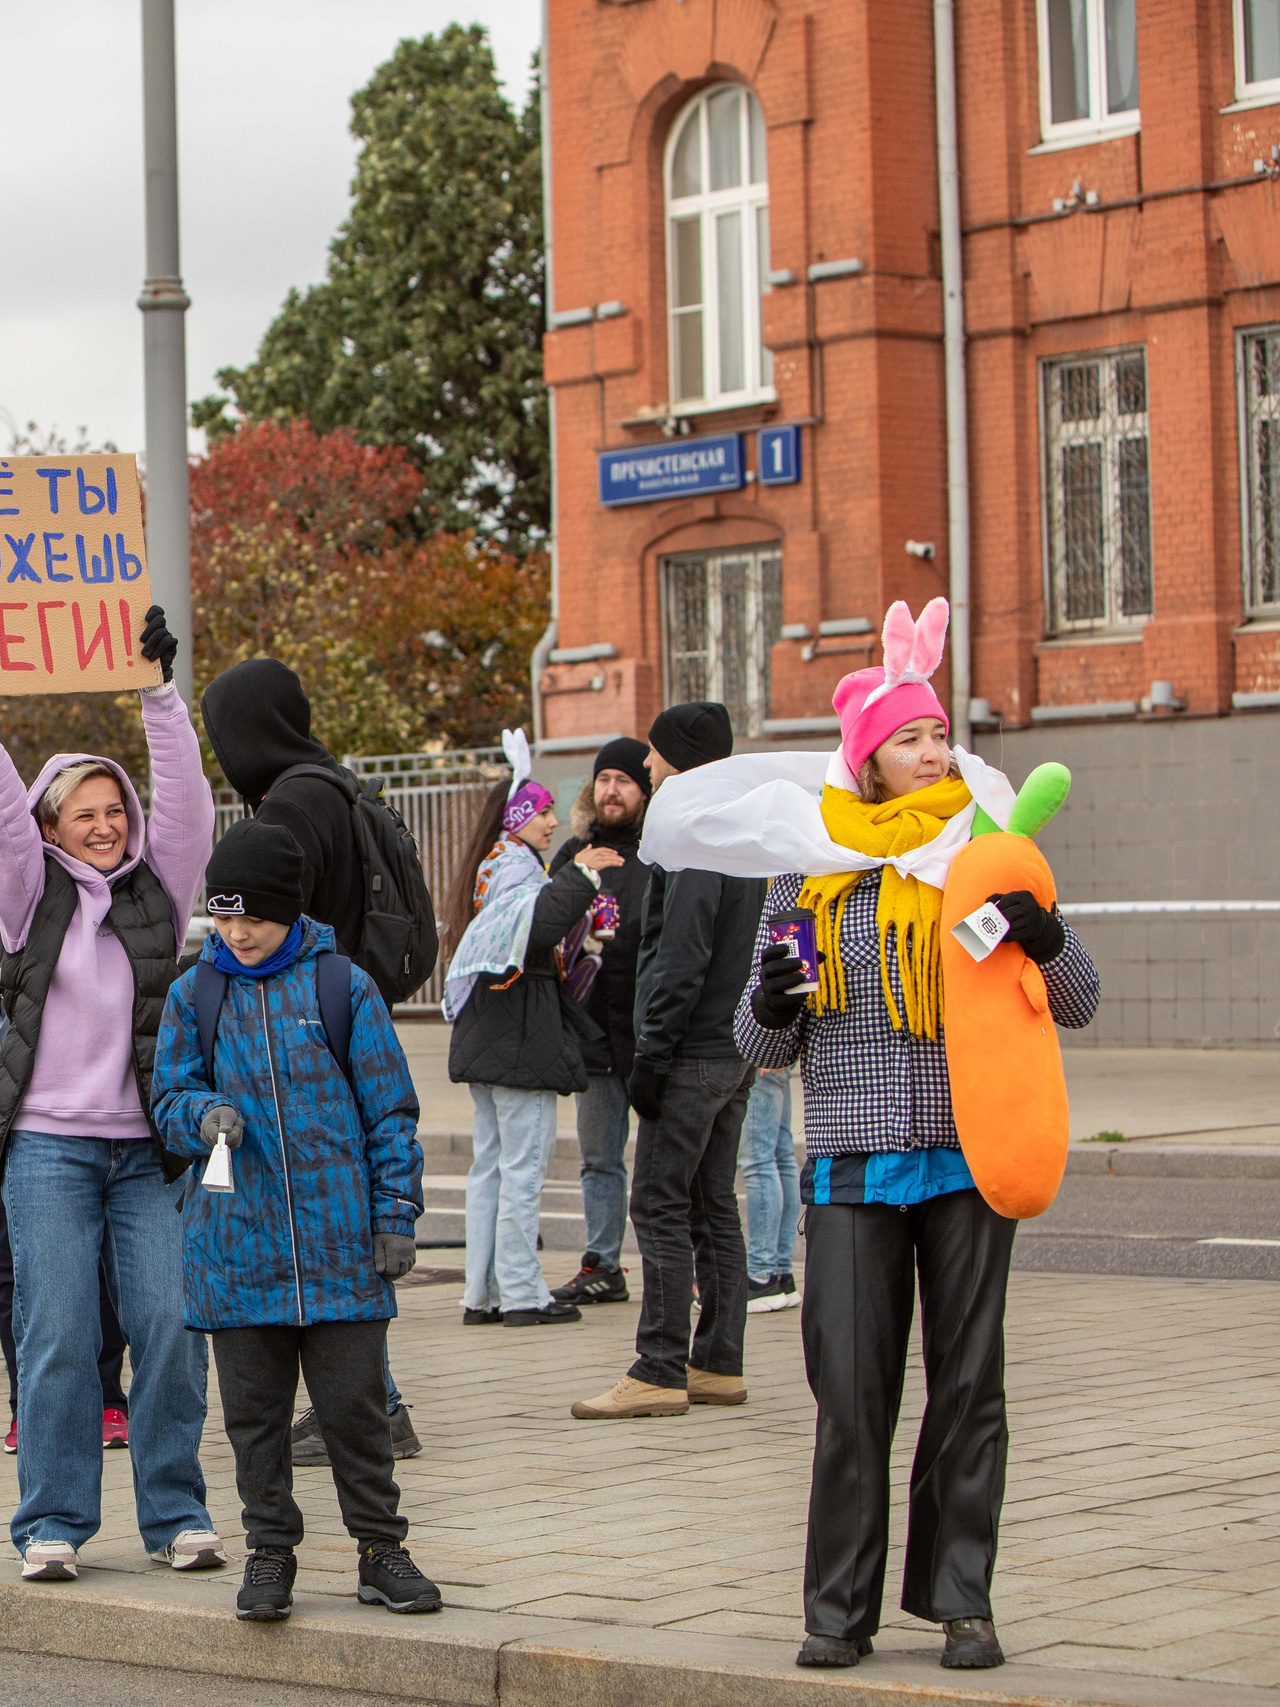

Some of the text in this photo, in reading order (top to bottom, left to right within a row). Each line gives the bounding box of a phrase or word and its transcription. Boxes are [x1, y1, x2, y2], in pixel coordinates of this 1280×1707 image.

[610, 446, 725, 483] ПРЕЧИСТЕНСКАЯ
[772, 437, 783, 473] 1
[36, 466, 117, 515] ТЫ
